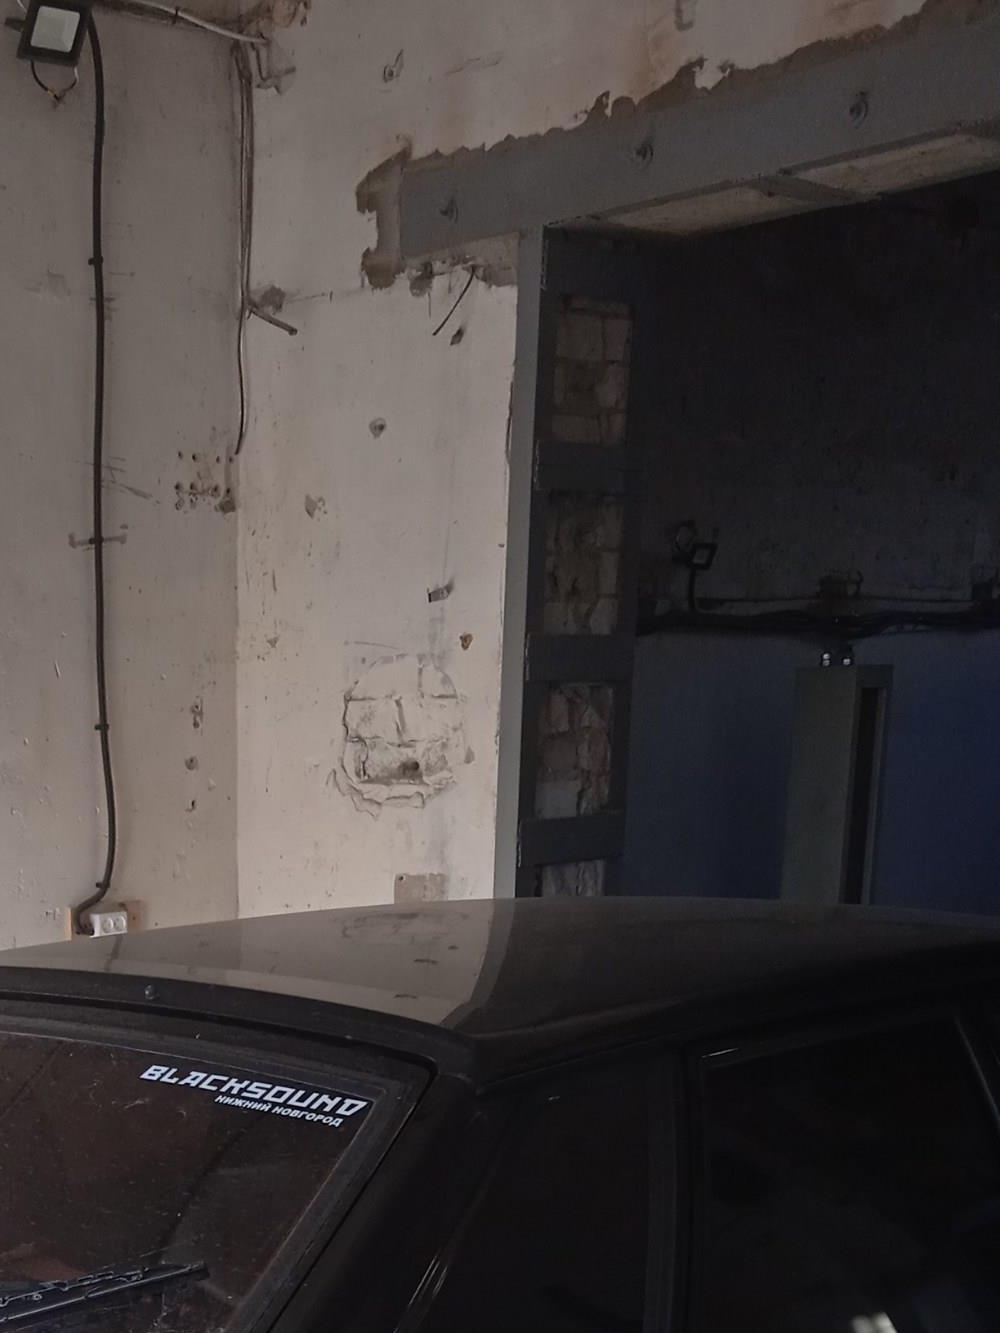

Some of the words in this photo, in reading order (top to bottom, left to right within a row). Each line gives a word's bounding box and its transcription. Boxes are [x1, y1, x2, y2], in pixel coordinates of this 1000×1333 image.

[140, 1064, 368, 1117] BLACKSOUND
[215, 1094, 272, 1113] НИЖНИЙ
[272, 1105, 344, 1128] НОВГОРОД
